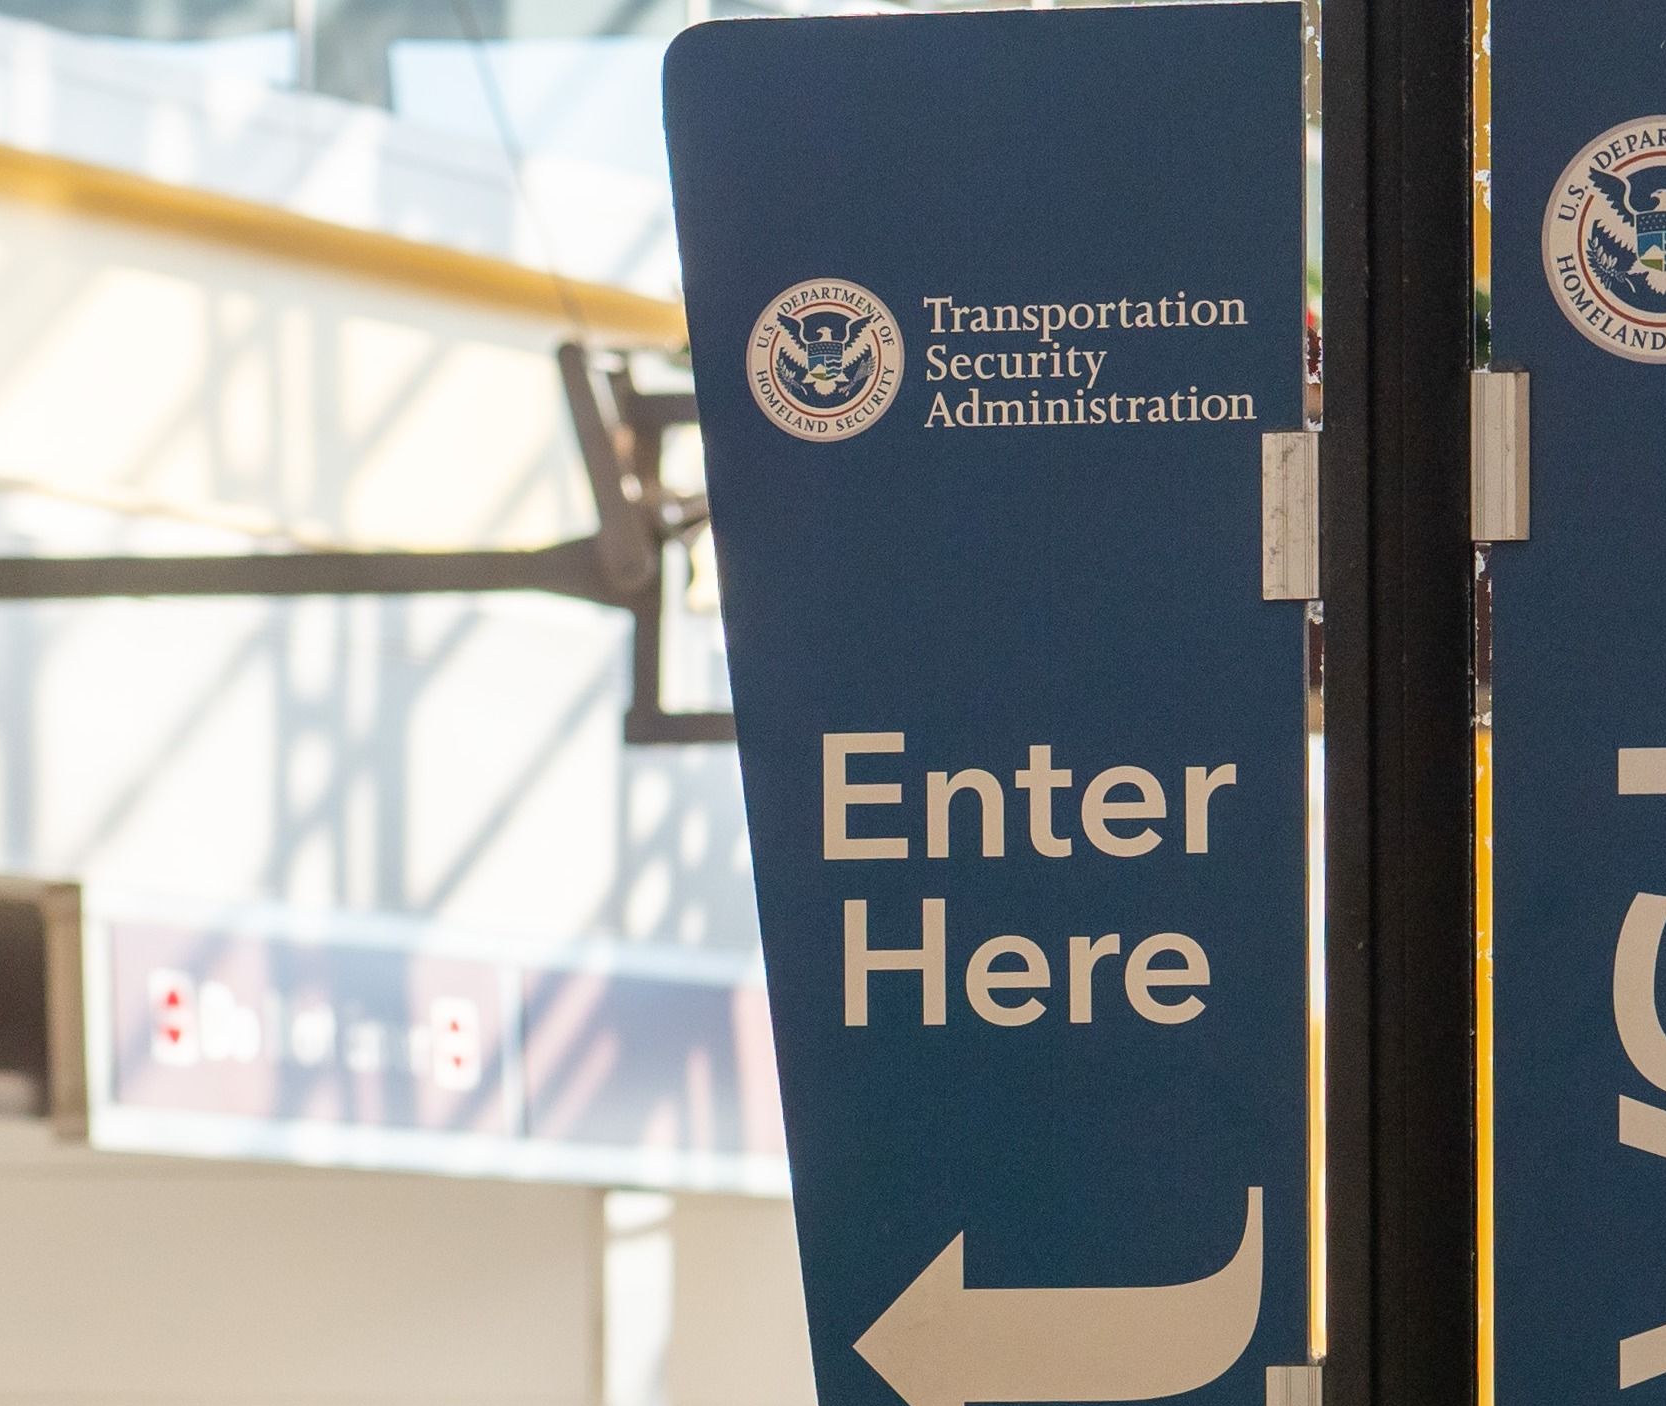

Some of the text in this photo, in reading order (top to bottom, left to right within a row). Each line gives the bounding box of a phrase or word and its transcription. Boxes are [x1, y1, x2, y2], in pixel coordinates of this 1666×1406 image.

[1558, 184, 1588, 221] U.S.
[756, 287, 895, 349] U.S. DEPARTMENT OF
[923, 291, 1249, 343] Transportation
[926, 343, 1108, 389] Security
[756, 366, 896, 433] HOMELAND SECURITY
[923, 386, 1258, 428] Administration
[823, 732, 1237, 861] Enter
[844, 897, 1211, 1027] Here
